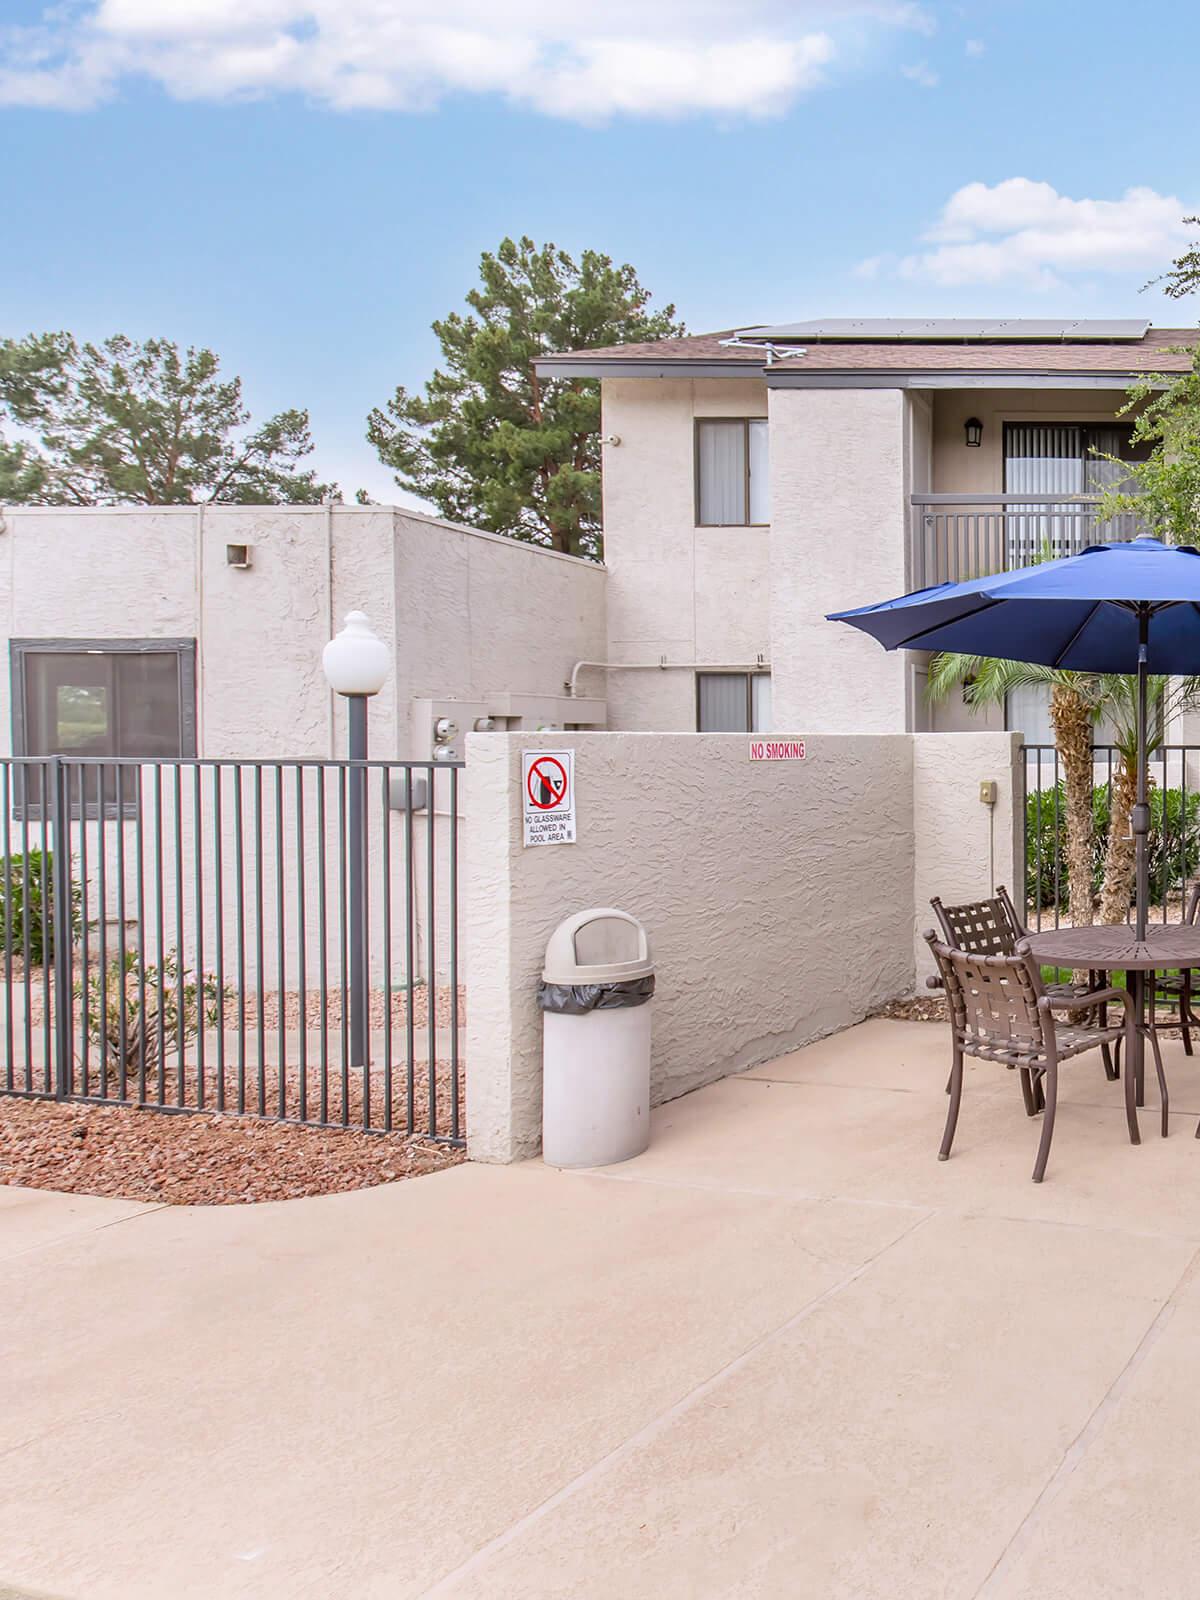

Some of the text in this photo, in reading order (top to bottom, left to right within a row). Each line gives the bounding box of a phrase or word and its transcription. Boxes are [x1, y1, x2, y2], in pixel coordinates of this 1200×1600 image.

[751, 743, 804, 758] NO SMOKING
[525, 813, 572, 824] NO GLASSWARE
[529, 823, 566, 833] ALLOWED IN
[530, 834, 545, 842] POOL
[548, 833, 564, 841] AREA
